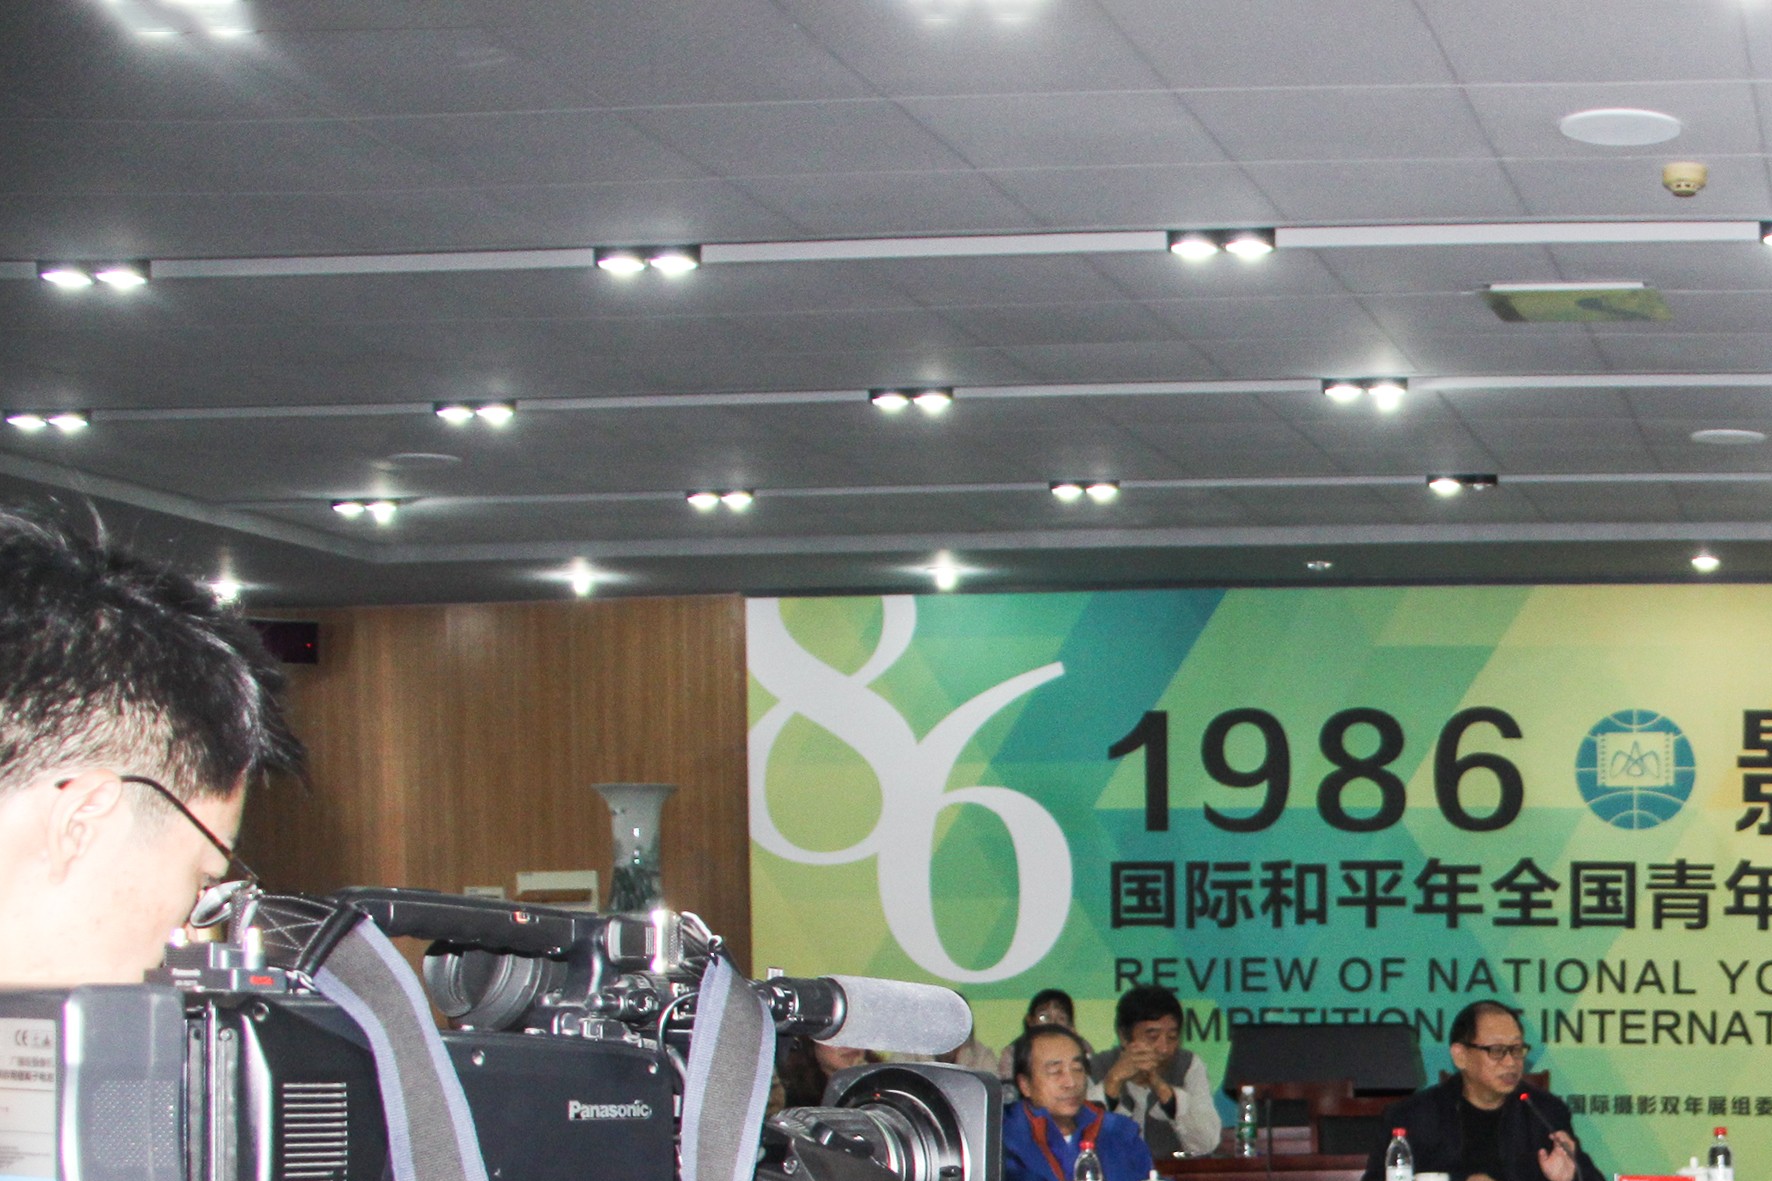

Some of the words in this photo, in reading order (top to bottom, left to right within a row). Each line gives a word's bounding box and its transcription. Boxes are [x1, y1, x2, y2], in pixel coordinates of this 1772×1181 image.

[1108, 707, 1523, 834] 1986
[1114, 957, 1319, 993] REVIEW
[1338, 957, 1406, 993] OF
[1428, 957, 1696, 995] NATIONAL
[568, 1099, 649, 1120] Panasonic
